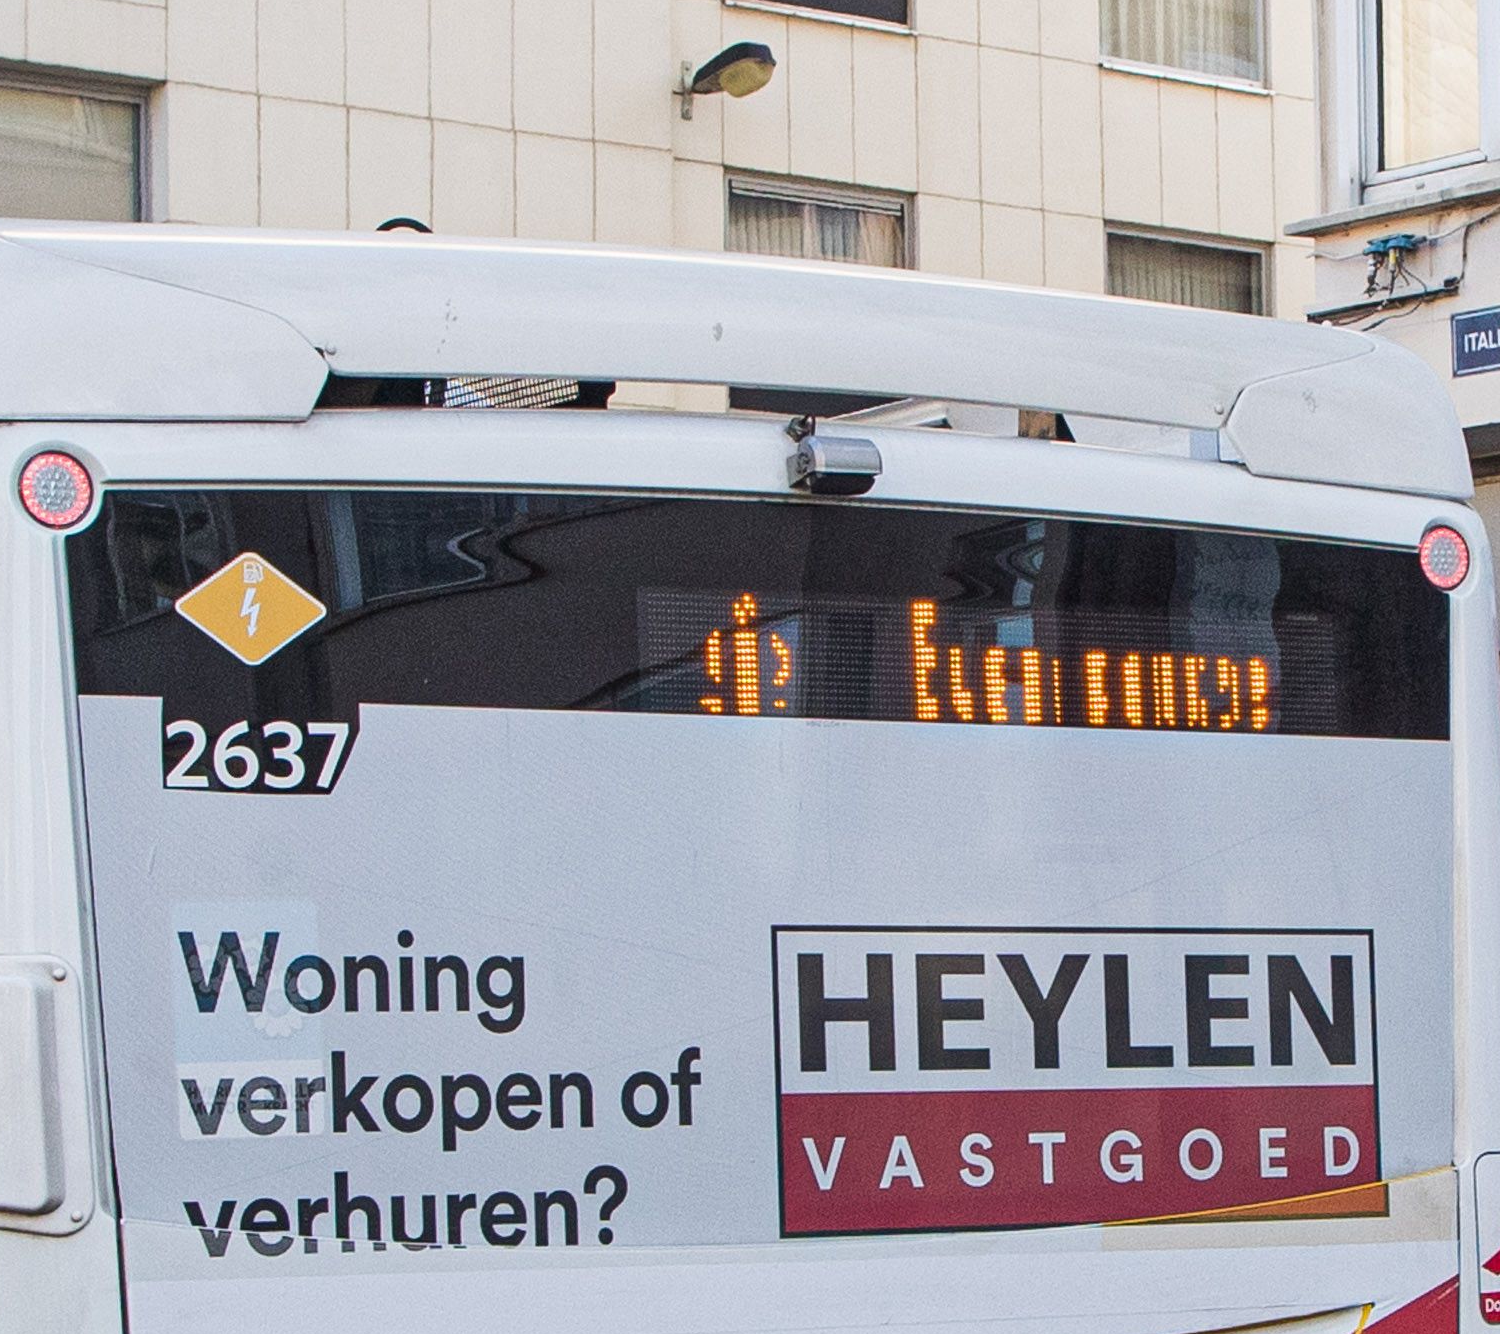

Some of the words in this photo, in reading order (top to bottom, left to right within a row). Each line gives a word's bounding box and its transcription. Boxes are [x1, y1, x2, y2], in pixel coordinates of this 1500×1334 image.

[165, 719, 350, 789] 2637
[177, 928, 526, 1034] Woning
[797, 952, 1357, 1072] HEYLEN
[180, 1051, 595, 1153] verkopen
[620, 1046, 702, 1128] of
[802, 1125, 1360, 1191] VASTGOED
[183, 1165, 629, 1258] verhuren?
